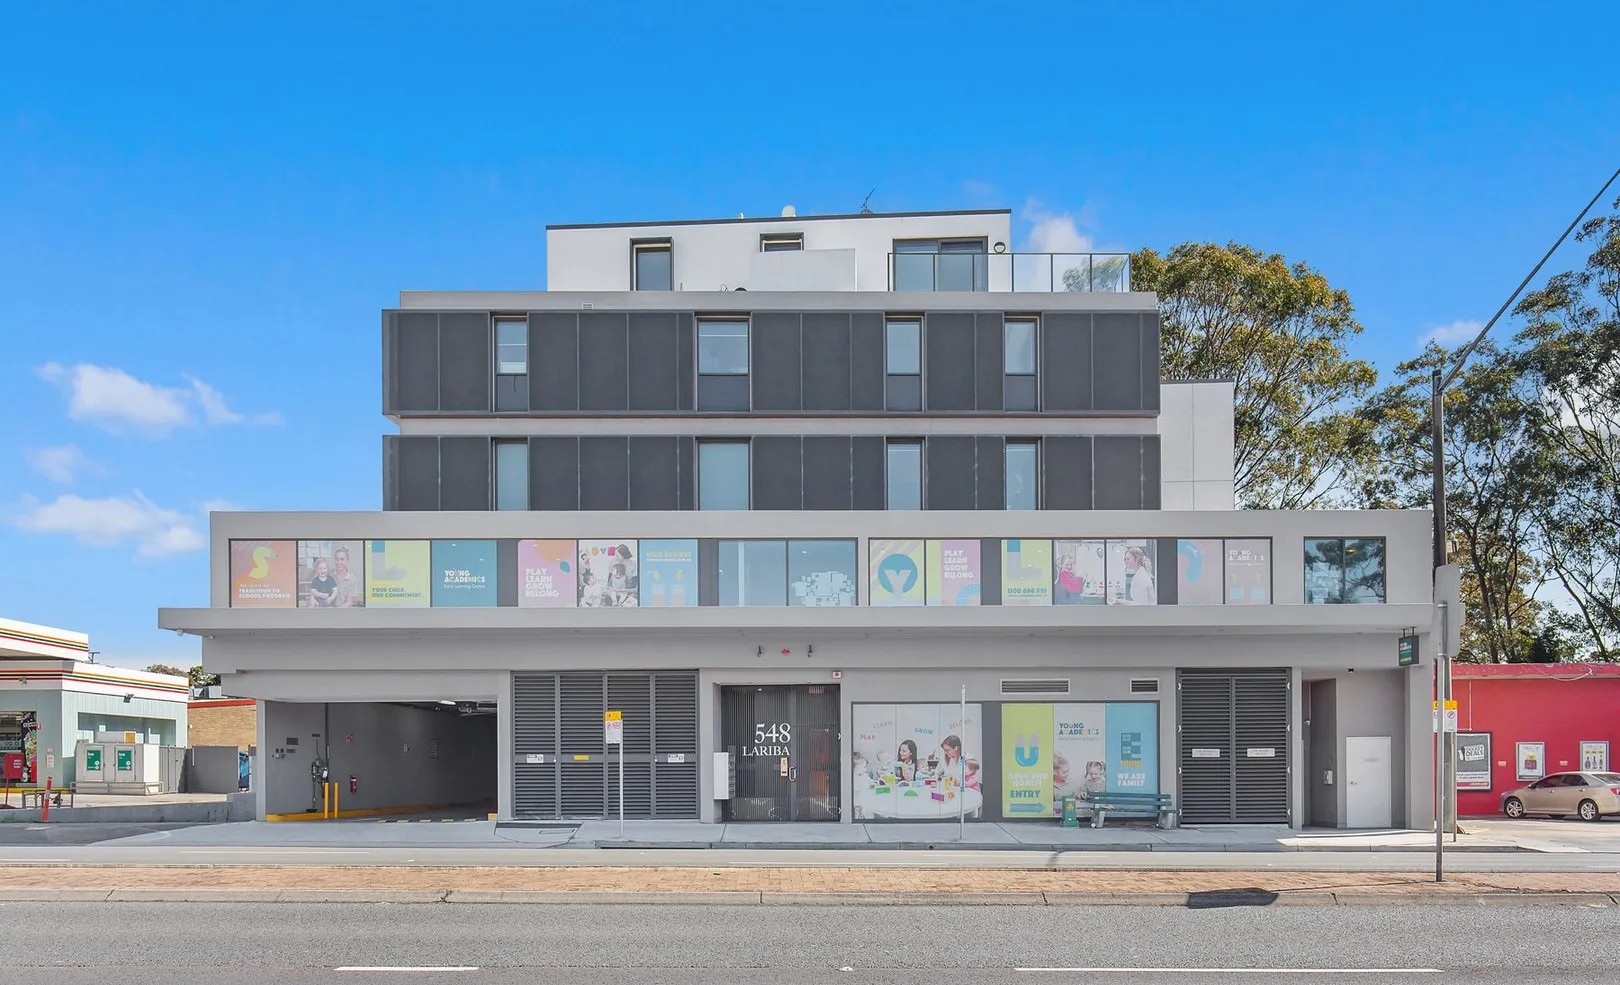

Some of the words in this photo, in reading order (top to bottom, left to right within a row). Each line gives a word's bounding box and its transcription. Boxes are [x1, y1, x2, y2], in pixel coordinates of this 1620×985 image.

[525, 568, 547, 576] PLAY
[944, 571, 974, 579] BELONG
[754, 722, 791, 744] 548
[914, 727, 934, 735] GROW
[742, 745, 791, 757] LARIBA
[1117, 772, 1130, 780] WE
[1131, 772, 1146, 780] ARE
[1010, 790, 1041, 798] ENTRY
